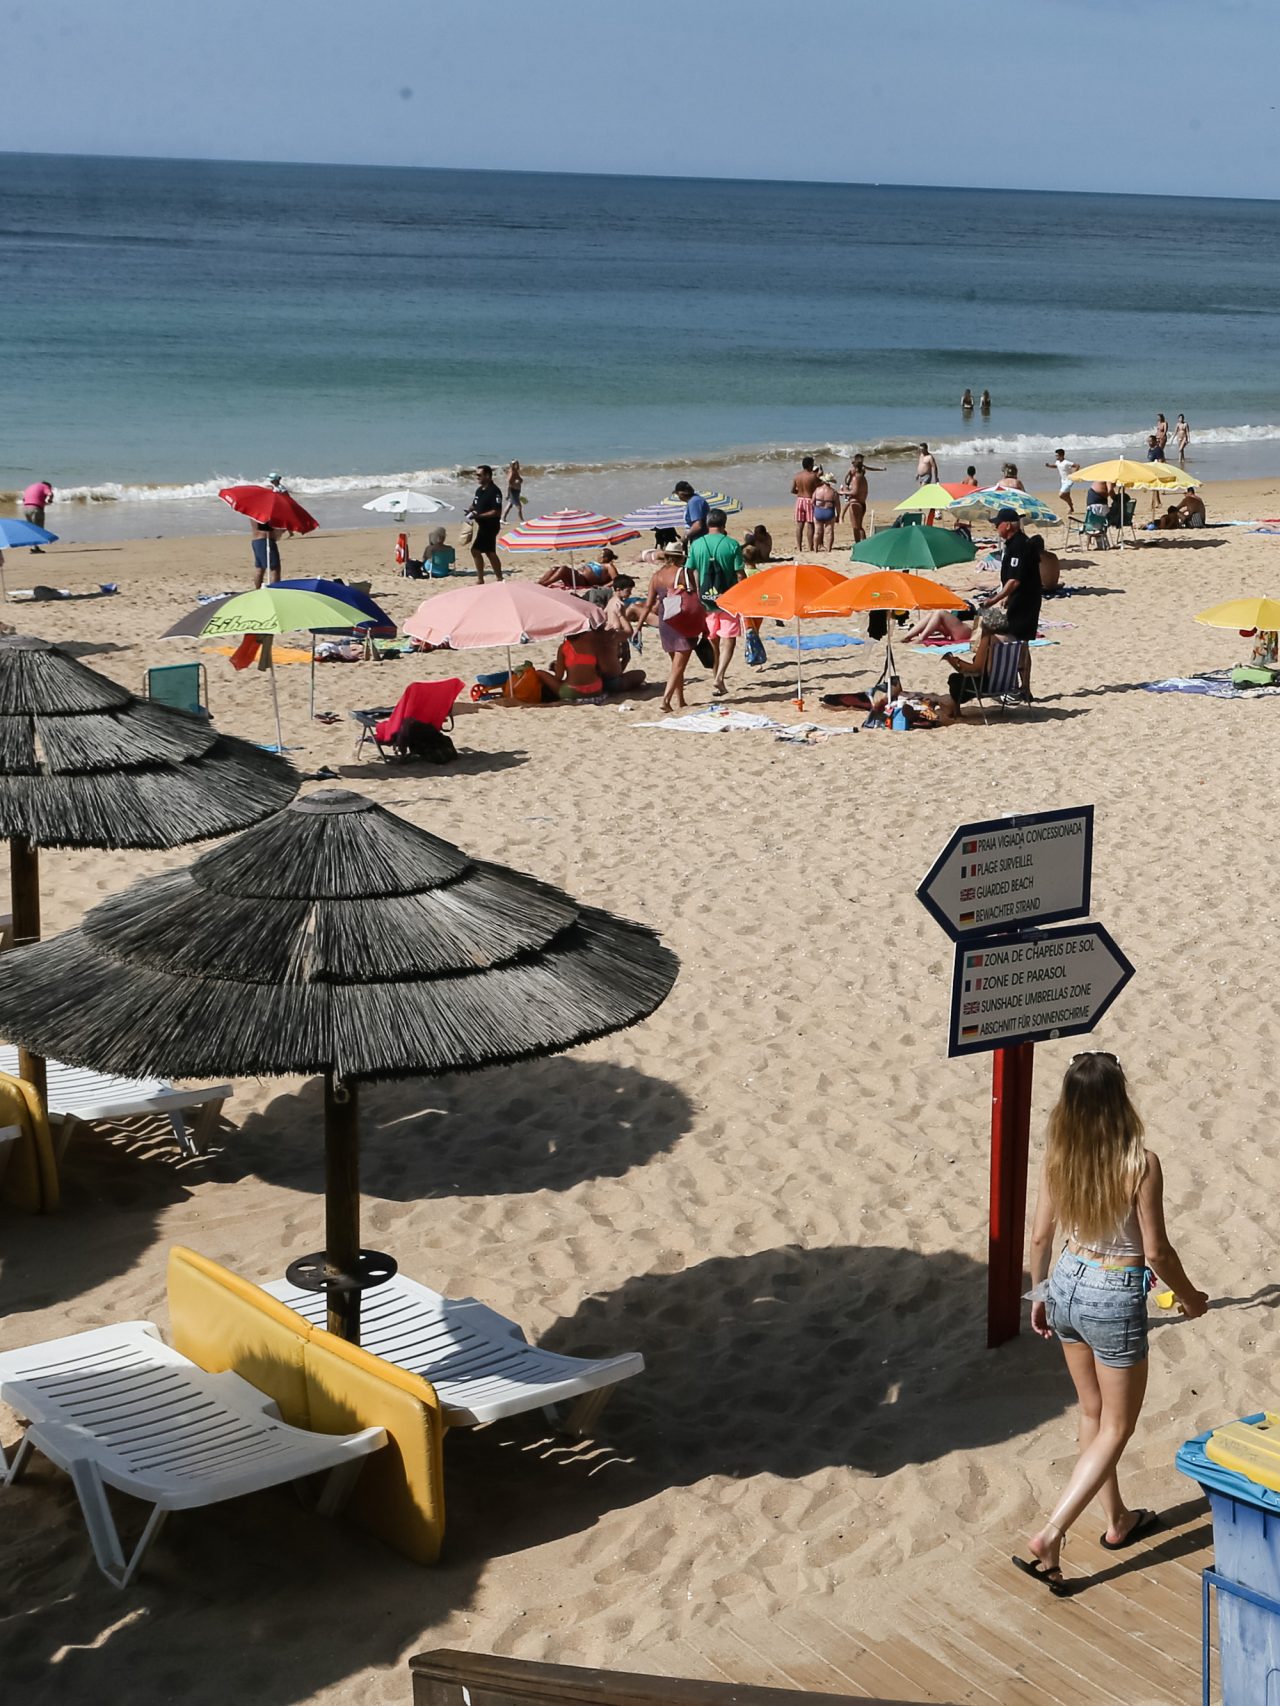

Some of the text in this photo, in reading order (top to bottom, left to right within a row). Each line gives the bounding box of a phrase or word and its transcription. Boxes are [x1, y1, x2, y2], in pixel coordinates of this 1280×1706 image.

[978, 822, 1082, 852] PRAIA VIGIADA CONCESSIONADA
[977, 860, 998, 876] PLAGE
[976, 876, 1034, 900] GUARDED BEACH
[976, 897, 1040, 922] BEWACHTER STRAND
[984, 952, 1009, 967] ZONA
[1012, 949, 1023, 962] DE
[1066, 941, 1076, 954] DE
[1078, 938, 1094, 952] SOL
[983, 966, 1066, 990] ZONE DE PARASOL
[981, 983, 1092, 1012] SUNSHADE UMBRELLAS ZONE
[980, 1005, 1090, 1036] ABSCHNITT FÜR SONNENSCHIRME
